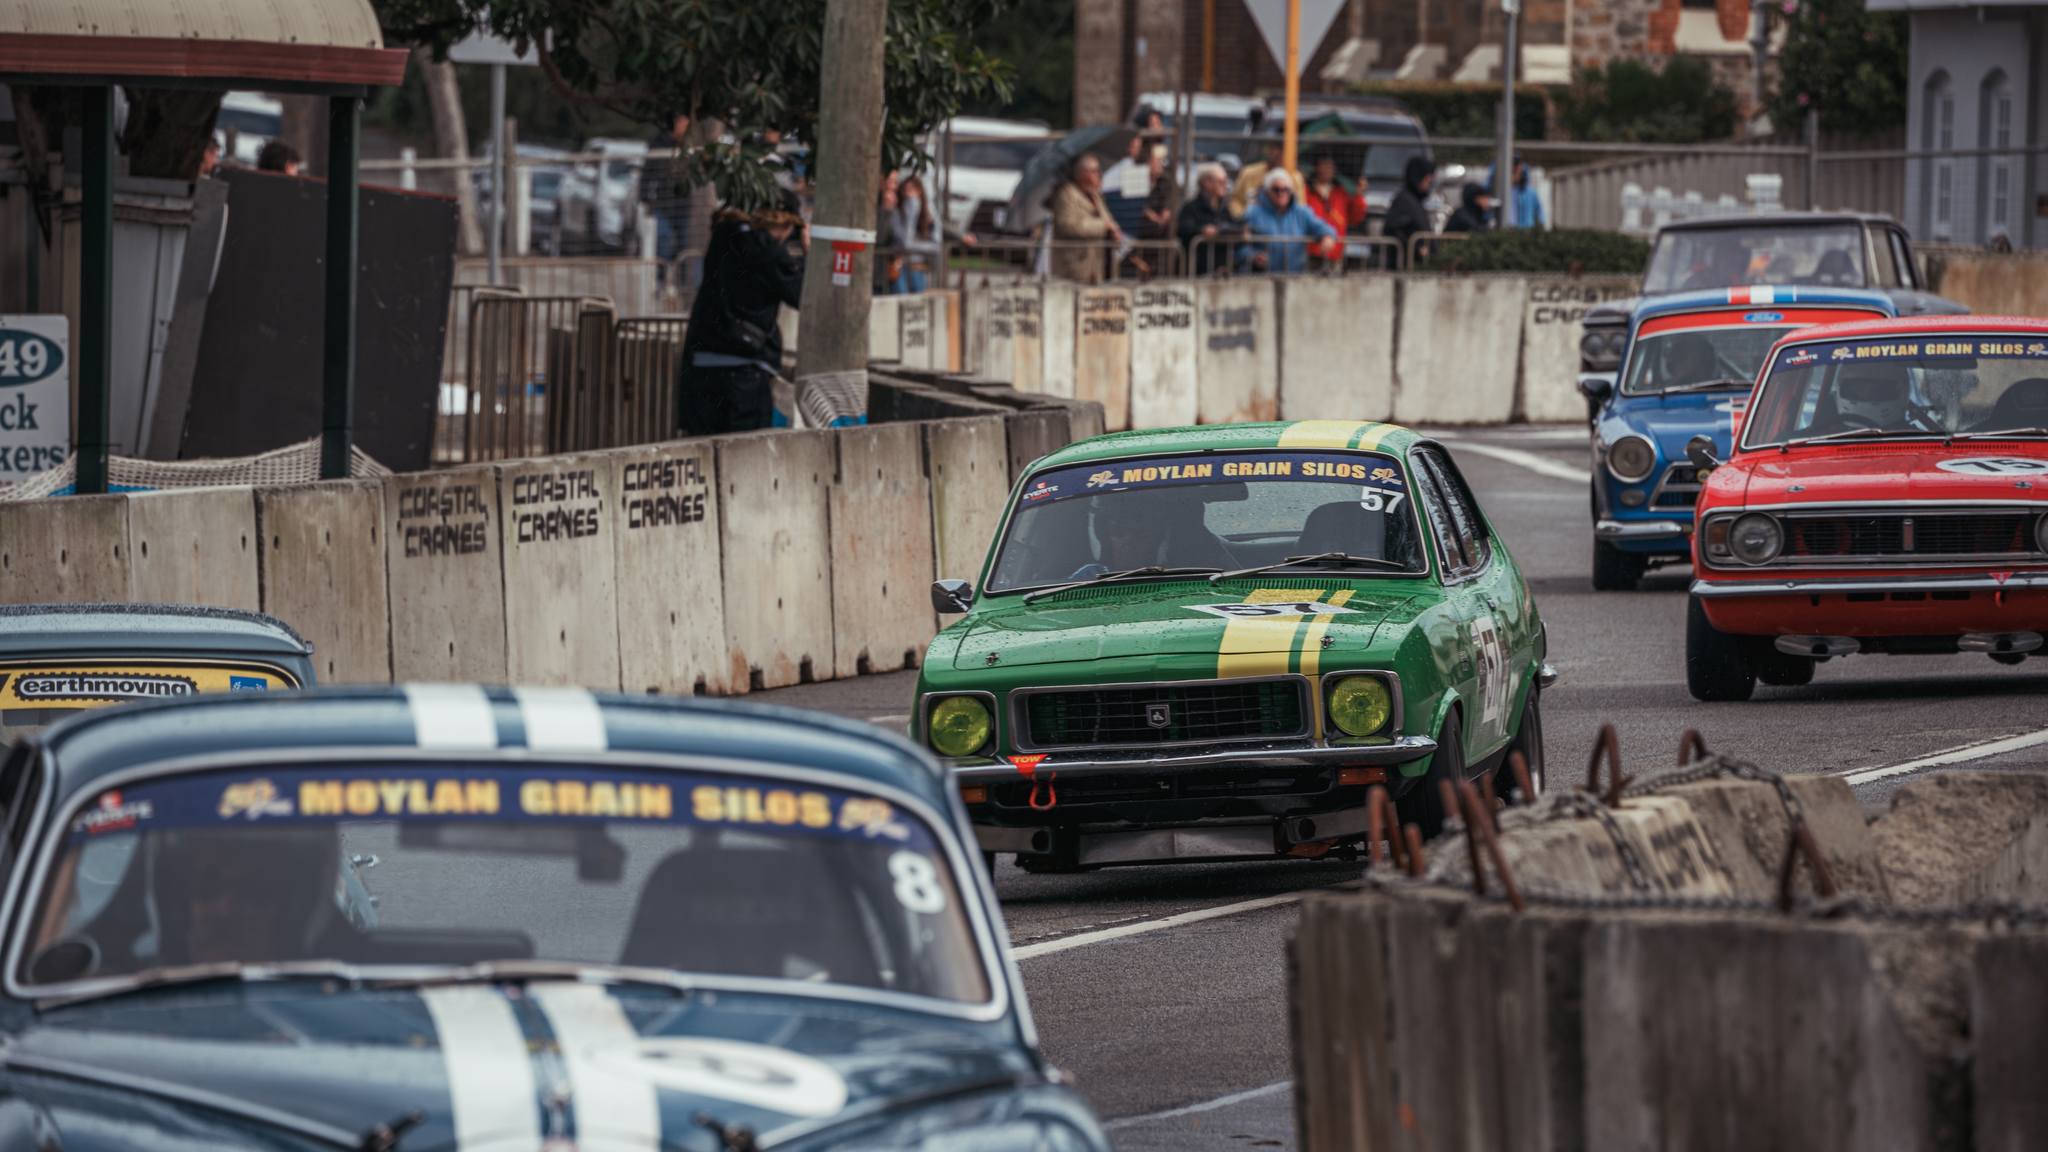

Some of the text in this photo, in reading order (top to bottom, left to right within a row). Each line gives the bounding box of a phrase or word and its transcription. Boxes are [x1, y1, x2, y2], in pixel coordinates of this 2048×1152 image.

[836, 252, 850, 271] H
[1534, 306, 1585, 324] CRA
[1856, 345, 1918, 358] MOYLAN
[1925, 344, 1972, 355] GRAIN
[1980, 344, 2023, 355] SILOS
[513, 470, 599, 504] COASTAL
[623, 458, 706, 491] COASTAL
[1122, 464, 1213, 483] MOYLAN
[1222, 462, 1292, 476] GRAIN
[1302, 462, 1366, 479] SILOS
[400, 484, 487, 518] COASTAL
[628, 494, 705, 528] CRANES
[1360, 486, 1405, 514] 57
[405, 521, 487, 557] CRANES
[518, 508, 599, 542] CRANES
[23, 678, 187, 696] earthmoving
[1015, 755, 1041, 763] TOW
[300, 780, 498, 814] MOYLAN
[519, 780, 672, 817] GRAIN
[691, 786, 832, 827] SILOS
[888, 850, 945, 914] 8
